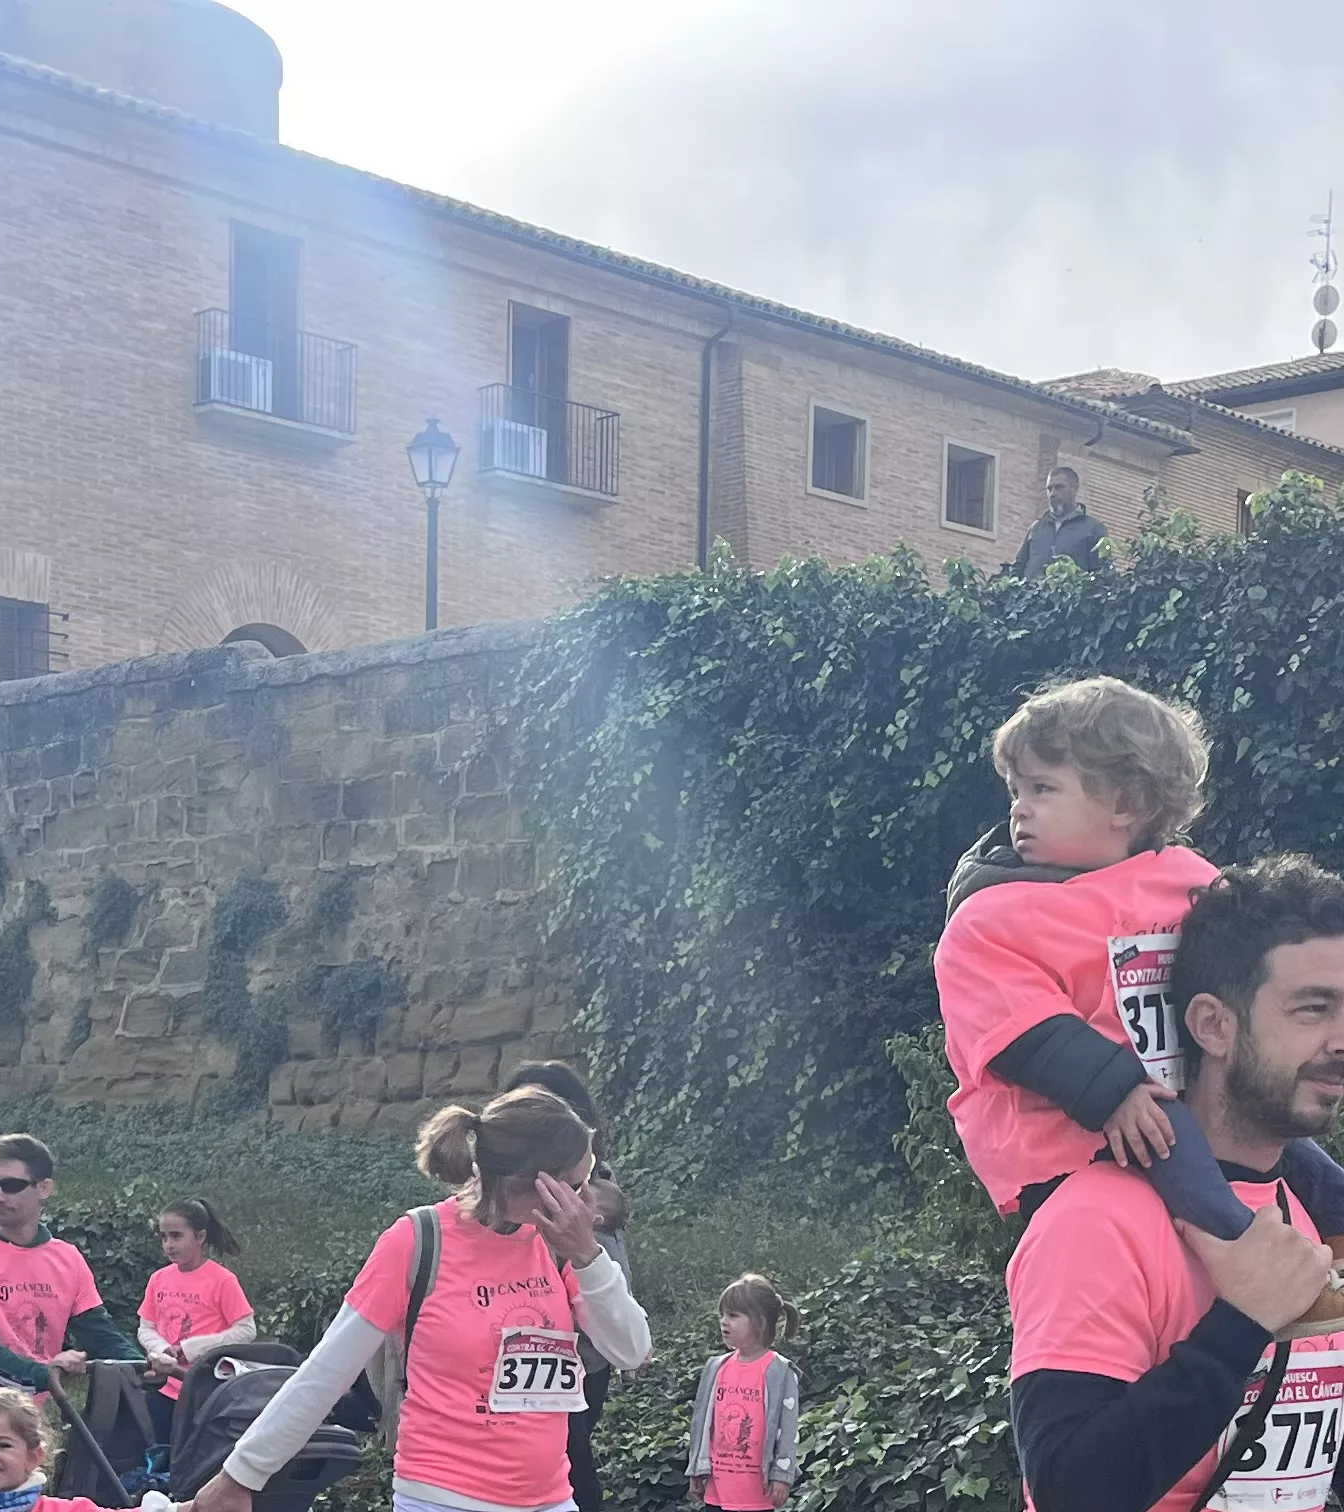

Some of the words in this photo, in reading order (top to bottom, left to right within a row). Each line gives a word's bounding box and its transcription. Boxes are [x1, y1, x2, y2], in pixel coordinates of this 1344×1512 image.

[1123, 992, 1176, 1055] 37
[499, 1357, 578, 1390] 3775
[1295, 1386, 1309, 1400] EL
[1311, 1381, 1344, 1400] CÁNCER
